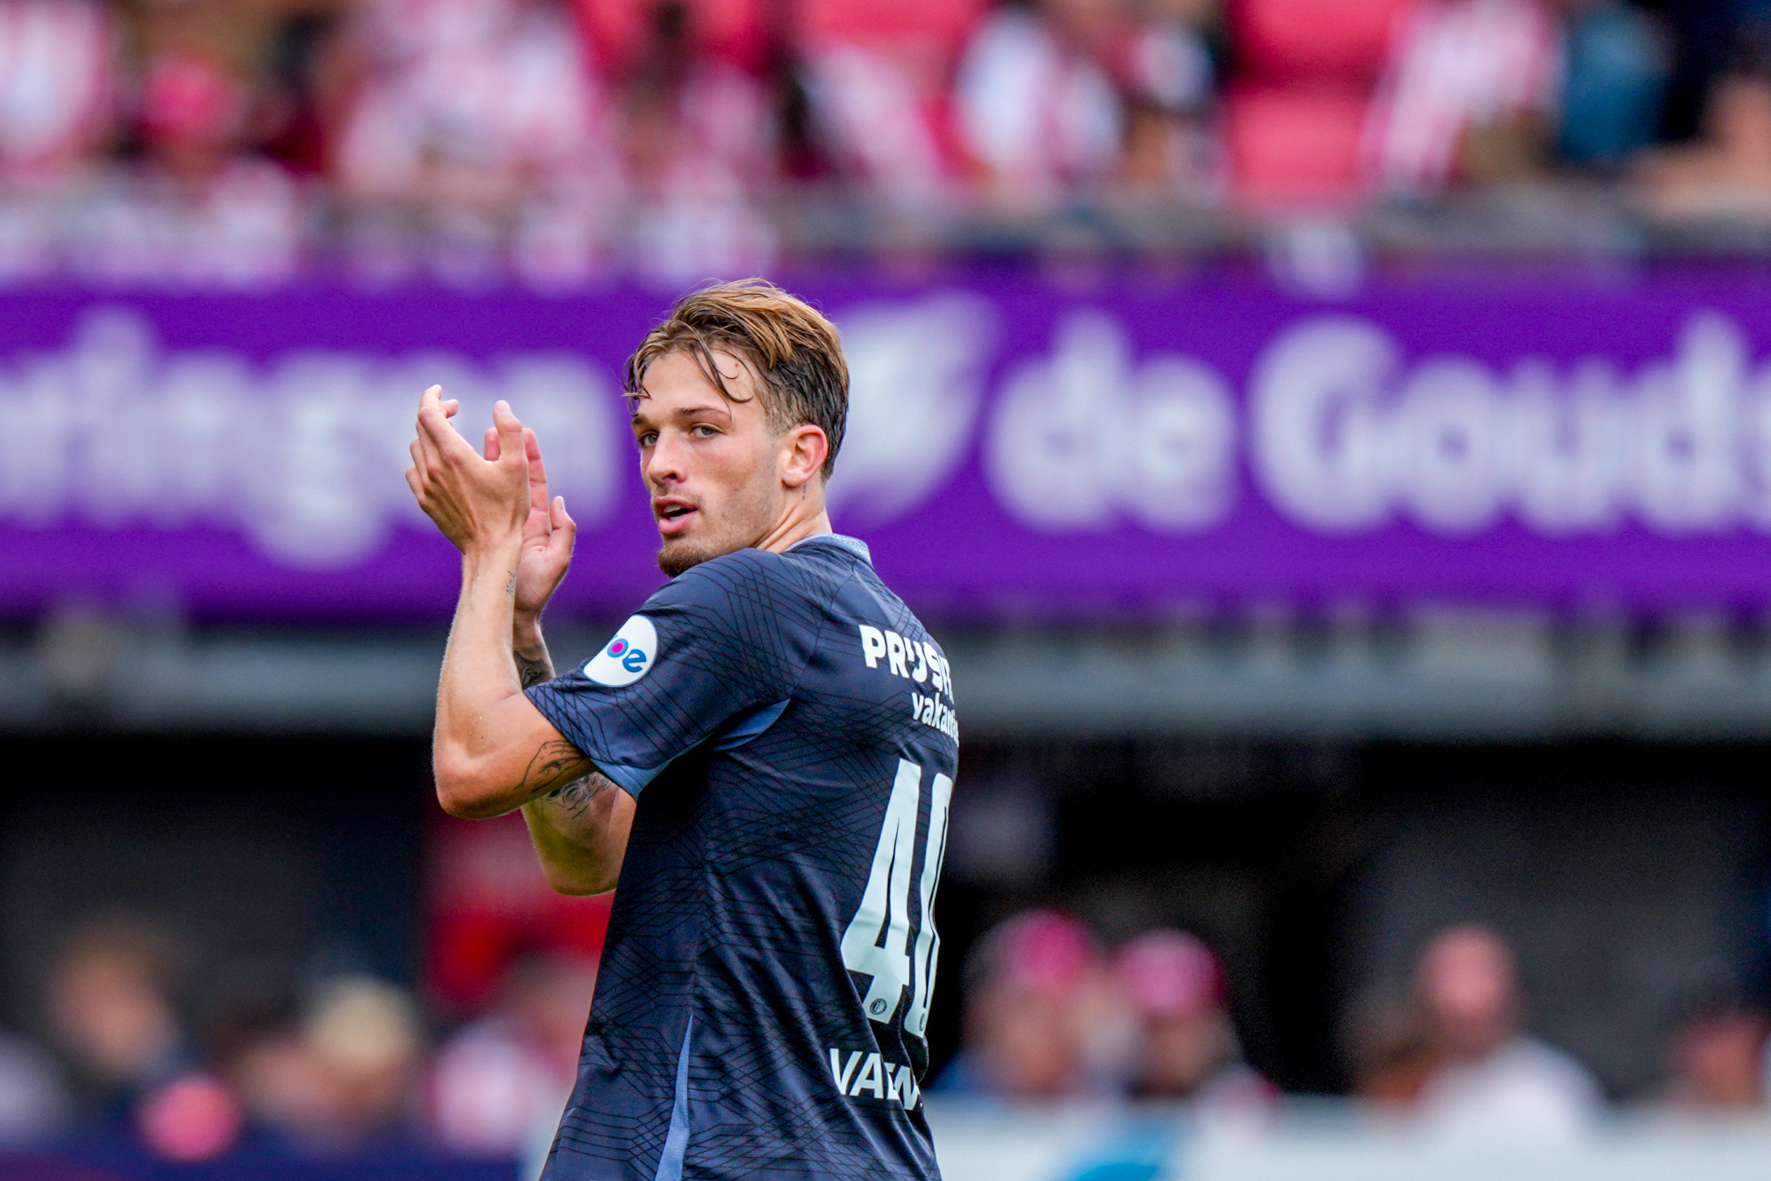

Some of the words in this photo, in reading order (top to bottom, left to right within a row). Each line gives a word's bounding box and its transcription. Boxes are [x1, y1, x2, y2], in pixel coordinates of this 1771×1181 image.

[985, 306, 1233, 534] de
[1251, 310, 1771, 536] Goud
[840, 757, 954, 1039] 40
